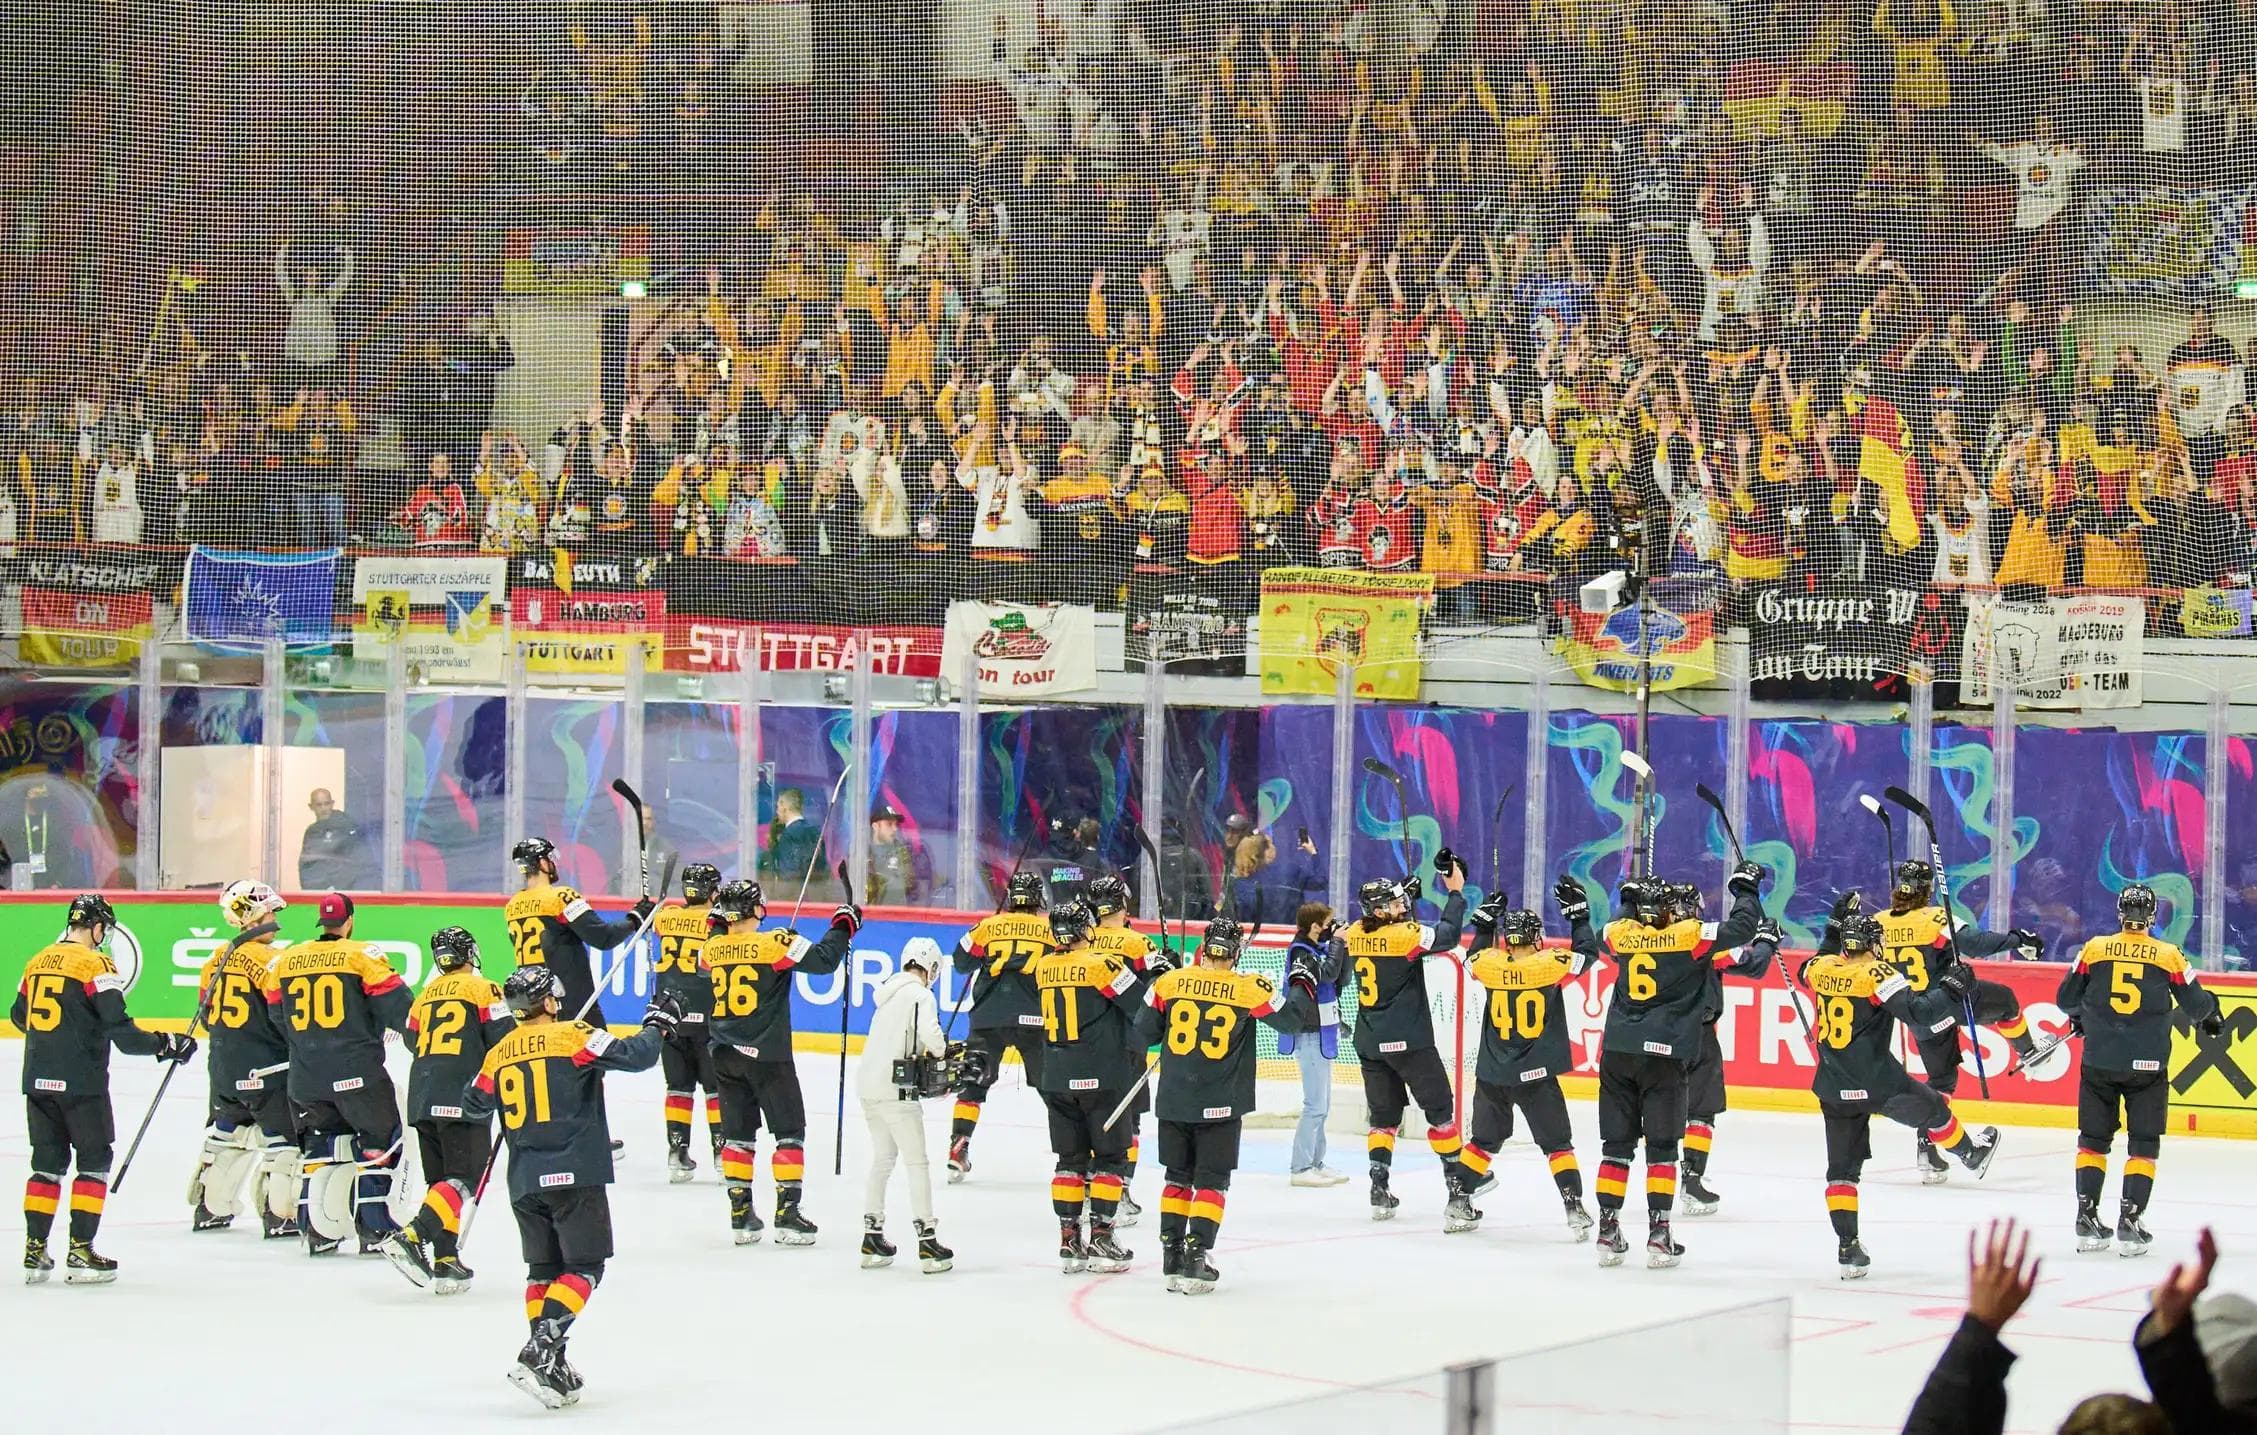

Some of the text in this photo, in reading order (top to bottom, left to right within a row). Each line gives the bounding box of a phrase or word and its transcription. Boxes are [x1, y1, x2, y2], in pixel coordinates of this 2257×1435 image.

[368, 573, 437, 584] STUTTGARTER
[524, 560, 620, 583] BAEUTH
[560, 602, 646, 622] HAMBURG
[1756, 588, 1874, 631] Gruppe
[2100, 605, 2125, 616] 2019
[2058, 623, 2124, 643] MAGDEBURG
[61, 637, 119, 658] TOUR
[526, 641, 616, 661] TUTTGART
[688, 624, 914, 675] STUTTGART
[1803, 643, 1881, 682] Tour
[1012, 669, 1056, 686] tour
[2093, 672, 2129, 691] TEAM
[2036, 689, 2062, 700] 2022
[1930, 842, 1950, 896] BAUER
[660, 916, 709, 935] MICHAELI
[987, 922, 1050, 940] FISCHBUCH
[1885, 928, 1914, 943] EIDER
[508, 917, 545, 966] 22
[2105, 942, 2158, 961] HOLZER
[288, 951, 347, 971] GRUBAUER
[709, 944, 759, 962] SORAMIES
[988, 940, 1044, 977] 77
[1042, 966, 1086, 984] MULLER
[1354, 957, 1379, 1007] 3
[1503, 970, 1526, 985] EHL
[1627, 953, 1657, 1001] 6
[1868, 963, 1894, 985] 38
[425, 981, 460, 1000] EHLIZ
[711, 965, 759, 1017] 26
[1177, 978, 1237, 1001] PFODERL
[2109, 962, 2144, 1015] 5
[26, 975, 65, 1032] 15
[288, 974, 345, 1032] 30
[1041, 987, 1079, 1042] 41
[1490, 989, 1546, 1040] 40
[416, 1001, 467, 1058] 42
[1168, 1000, 1238, 1060] 83
[497, 1034, 546, 1063] MULLER
[498, 1058, 551, 1130] 91
[438, 1107, 460, 1116] IIHF
[548, 1174, 572, 1184] IIHF
